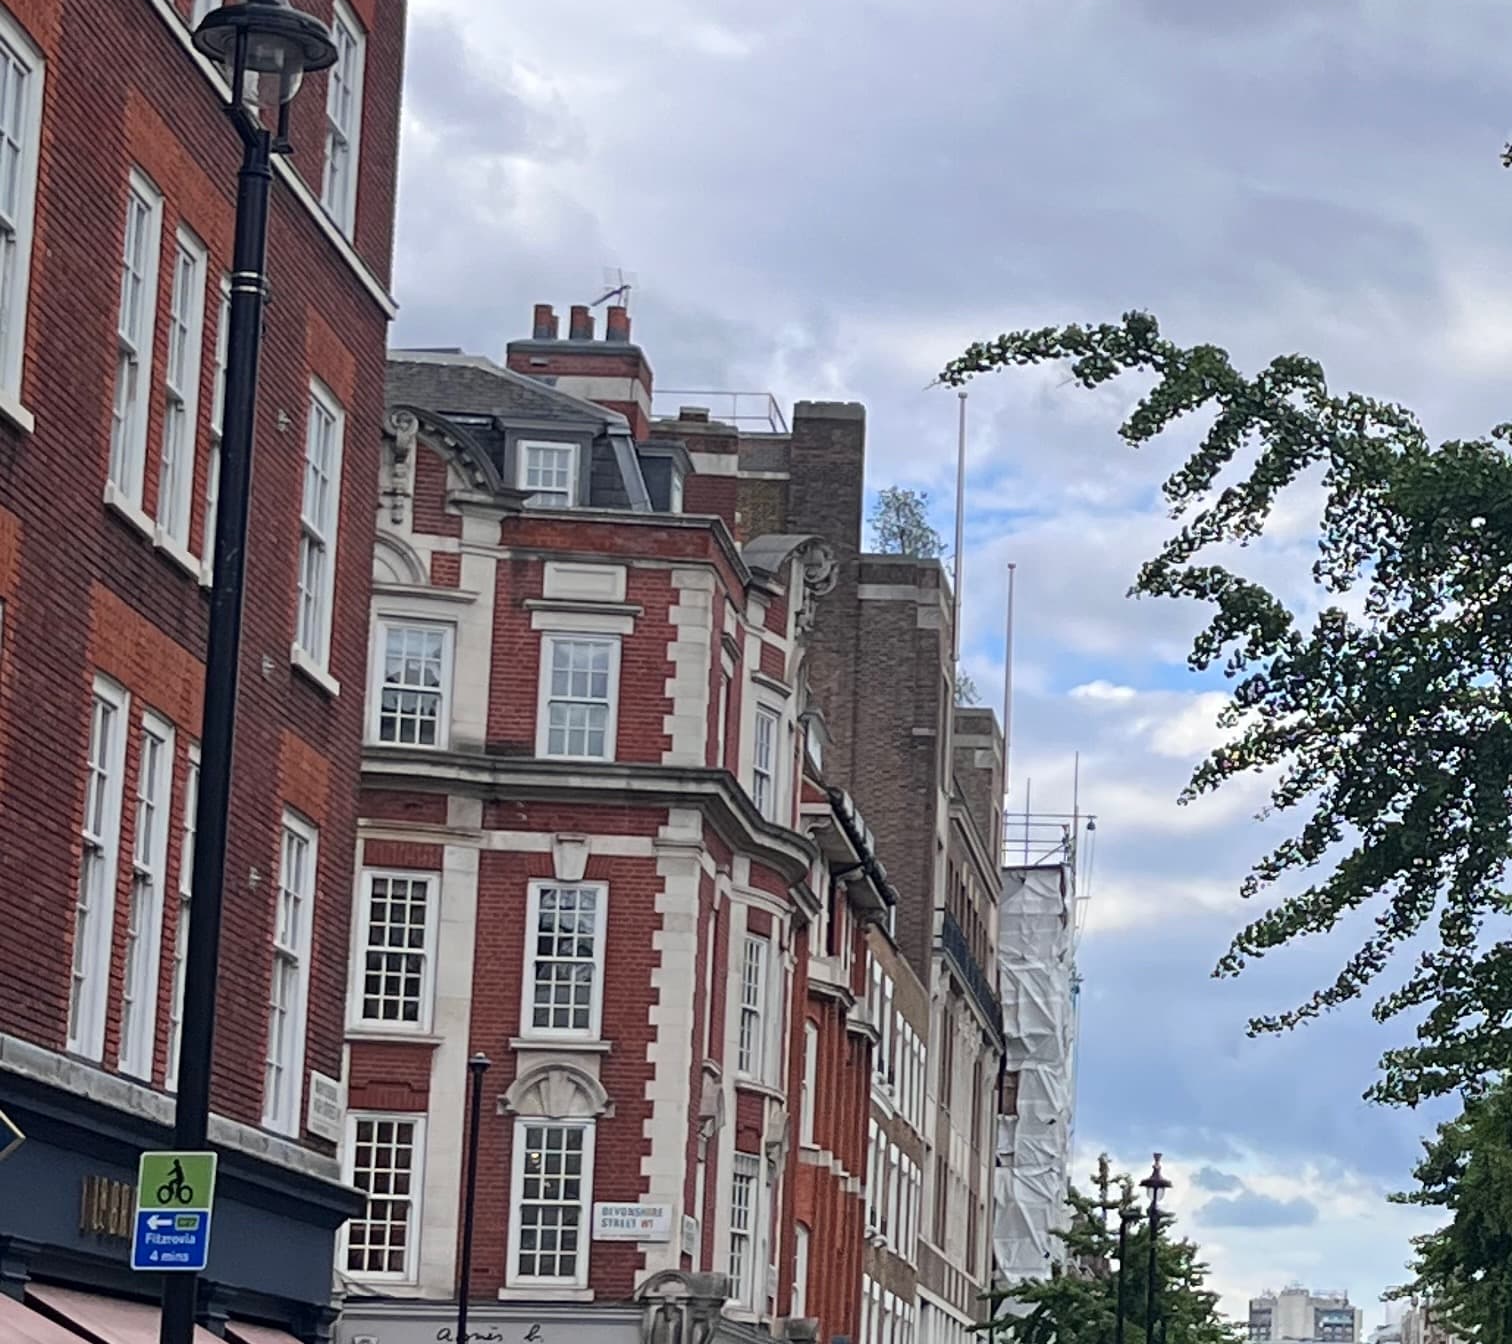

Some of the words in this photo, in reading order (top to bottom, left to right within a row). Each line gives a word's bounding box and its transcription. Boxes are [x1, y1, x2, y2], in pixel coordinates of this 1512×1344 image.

[601, 1218, 637, 1228] STREET
[145, 1232, 196, 1245] Fitzrovia
[149, 1250, 159, 1262] 4
[160, 1250, 189, 1262] mins
